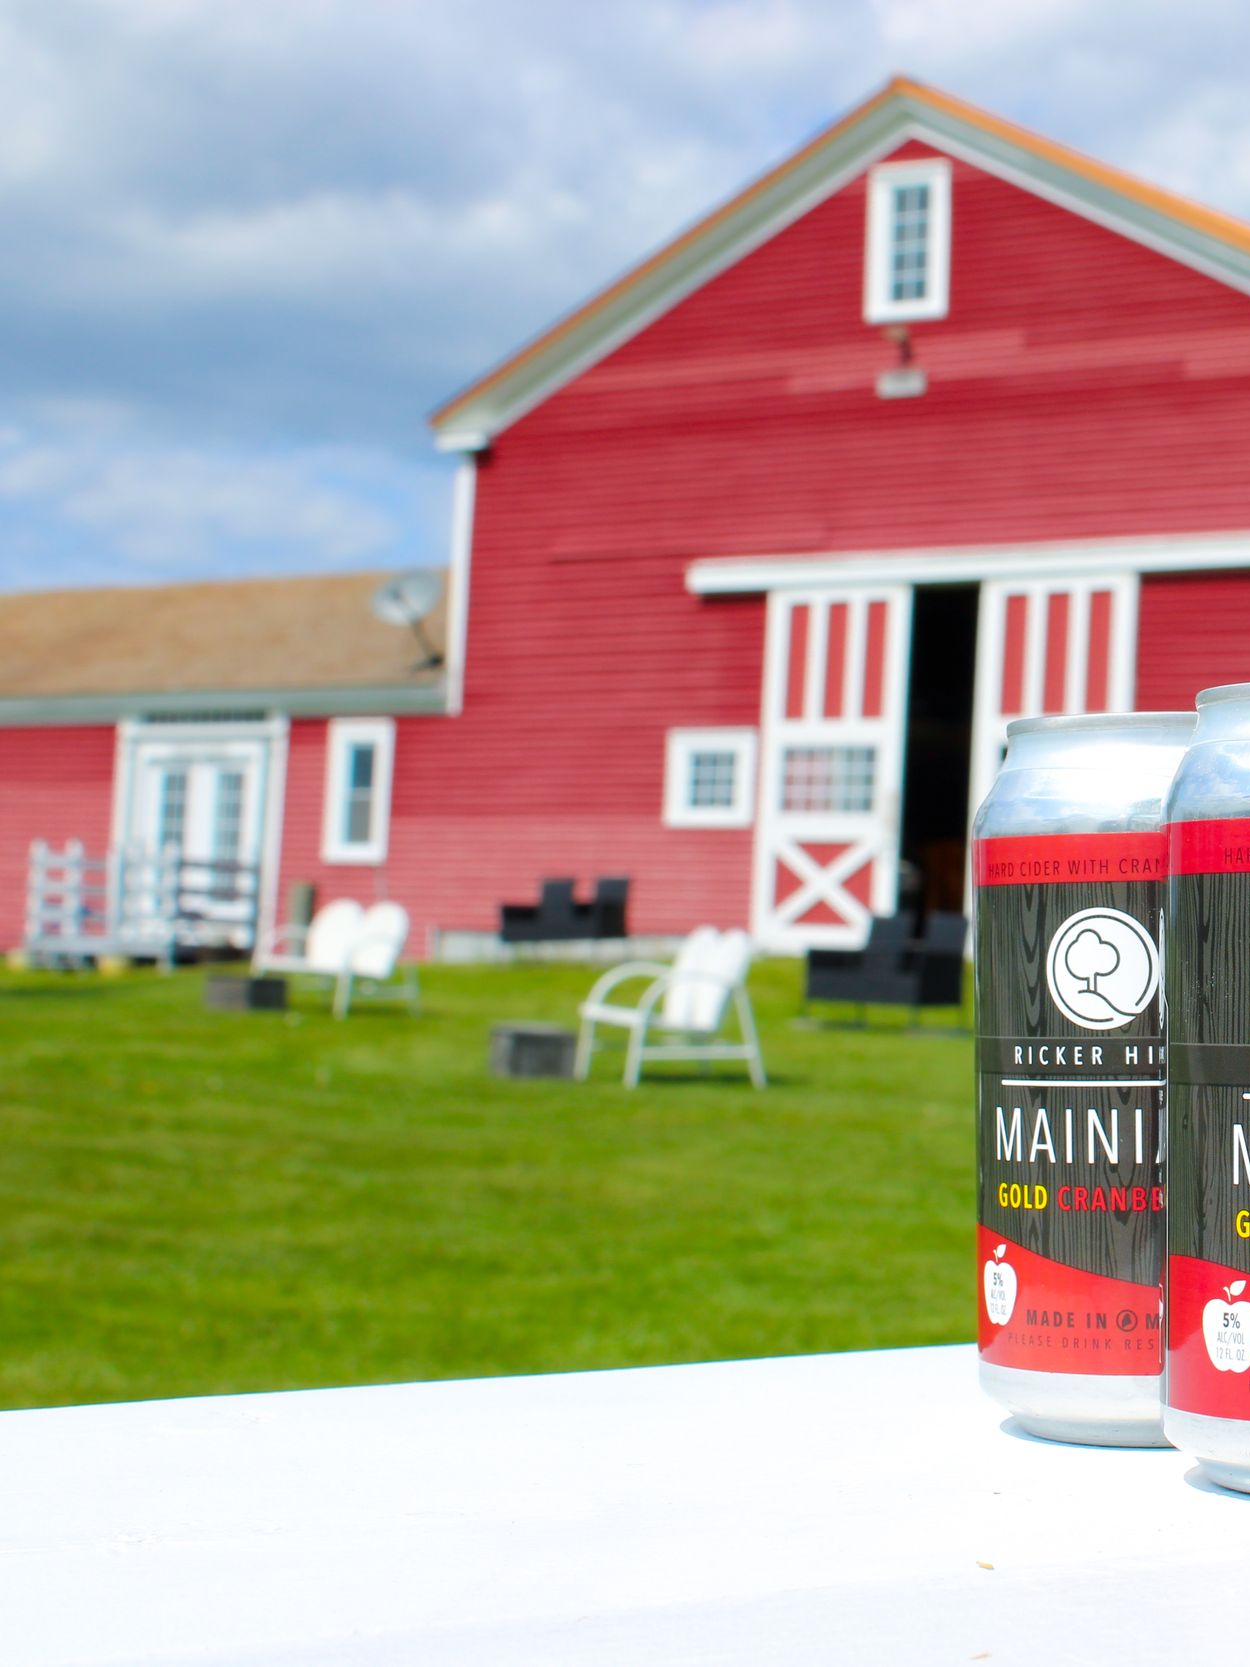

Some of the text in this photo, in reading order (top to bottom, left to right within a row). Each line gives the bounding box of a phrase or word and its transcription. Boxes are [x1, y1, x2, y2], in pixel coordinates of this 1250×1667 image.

[988, 862, 1014, 878] HARD
[1020, 860, 1060, 878] CIDER
[1068, 859, 1109, 875] WITH
[1014, 1046, 1102, 1065] RICKER
[996, 1106, 1162, 1164] MAINI
[999, 1182, 1048, 1210] GOLD
[1026, 1309, 1075, 1328] MADE
[1087, 1312, 1106, 1329] IN
[1222, 1312, 1240, 1329] 5%
[1008, 1332, 1051, 1347] PLEASE
[1062, 1338, 1112, 1350] DRINK
[1216, 1331, 1245, 1346] ALC/VOL
[1216, 1347, 1224, 1360] 12
